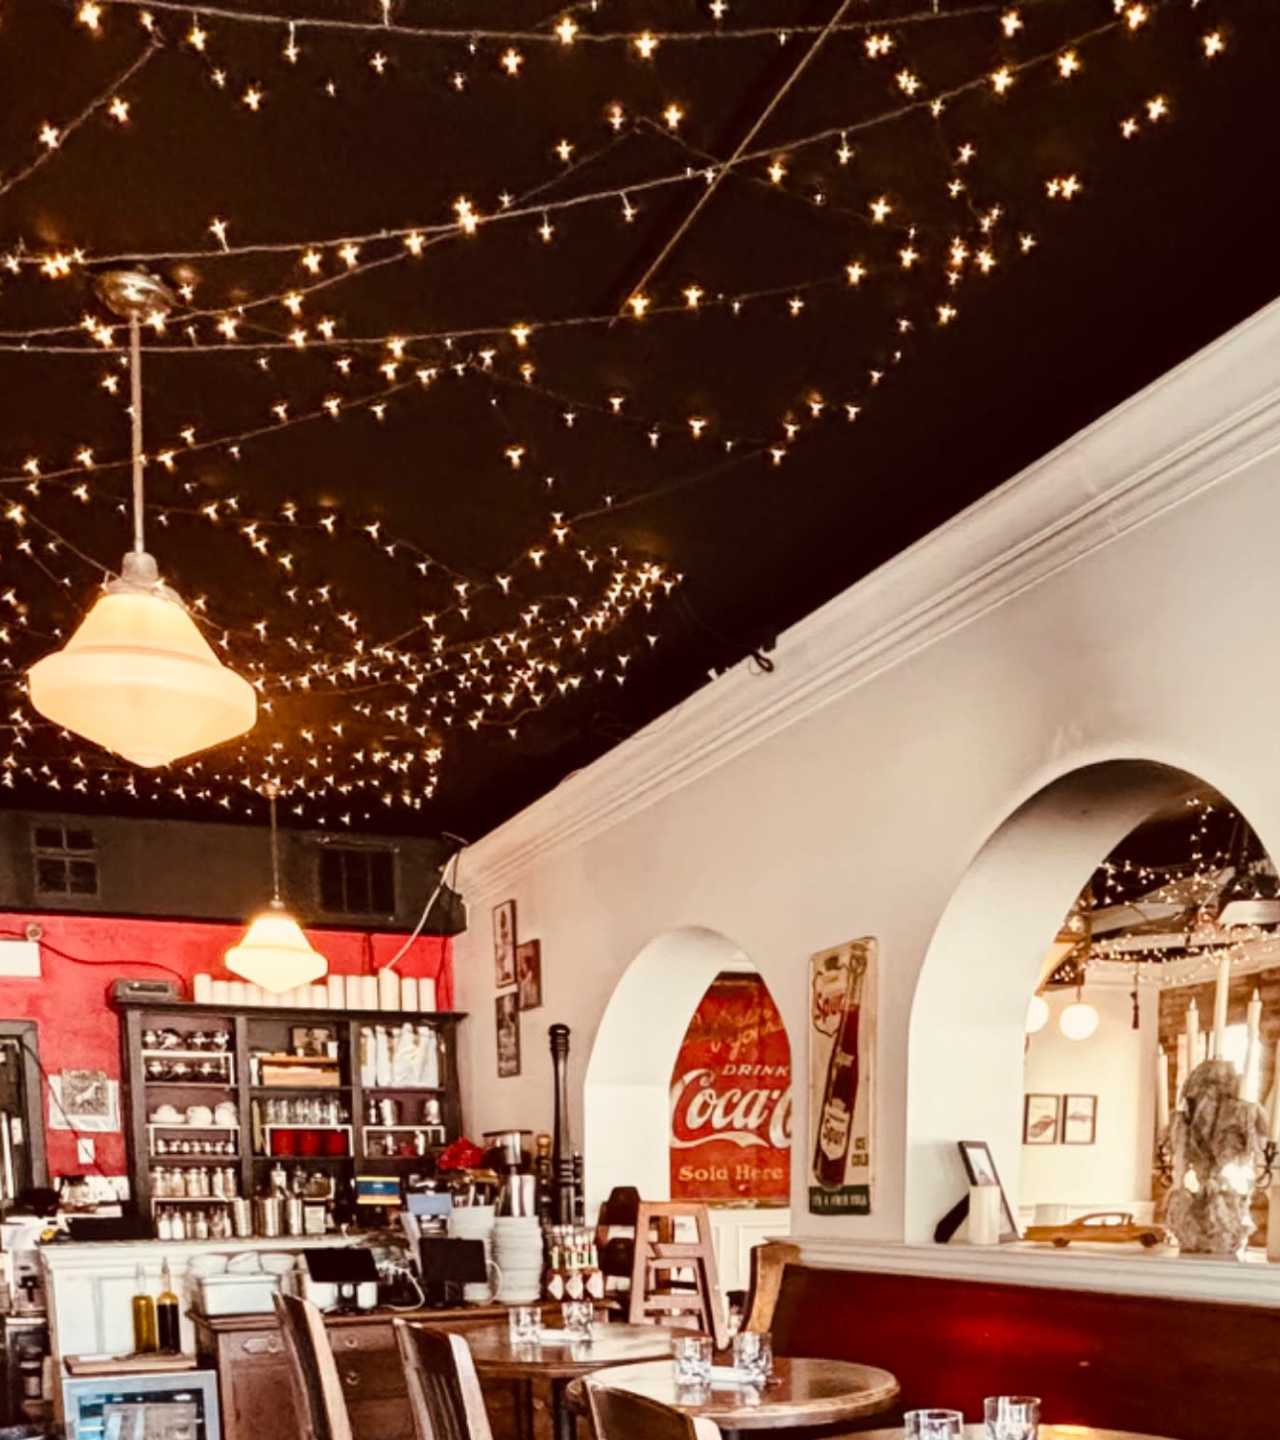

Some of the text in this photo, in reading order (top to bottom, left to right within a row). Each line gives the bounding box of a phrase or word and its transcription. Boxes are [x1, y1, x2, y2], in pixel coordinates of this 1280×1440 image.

[721, 1063, 790, 1077] DRINK
[678, 1163, 784, 1181] Sold Here
